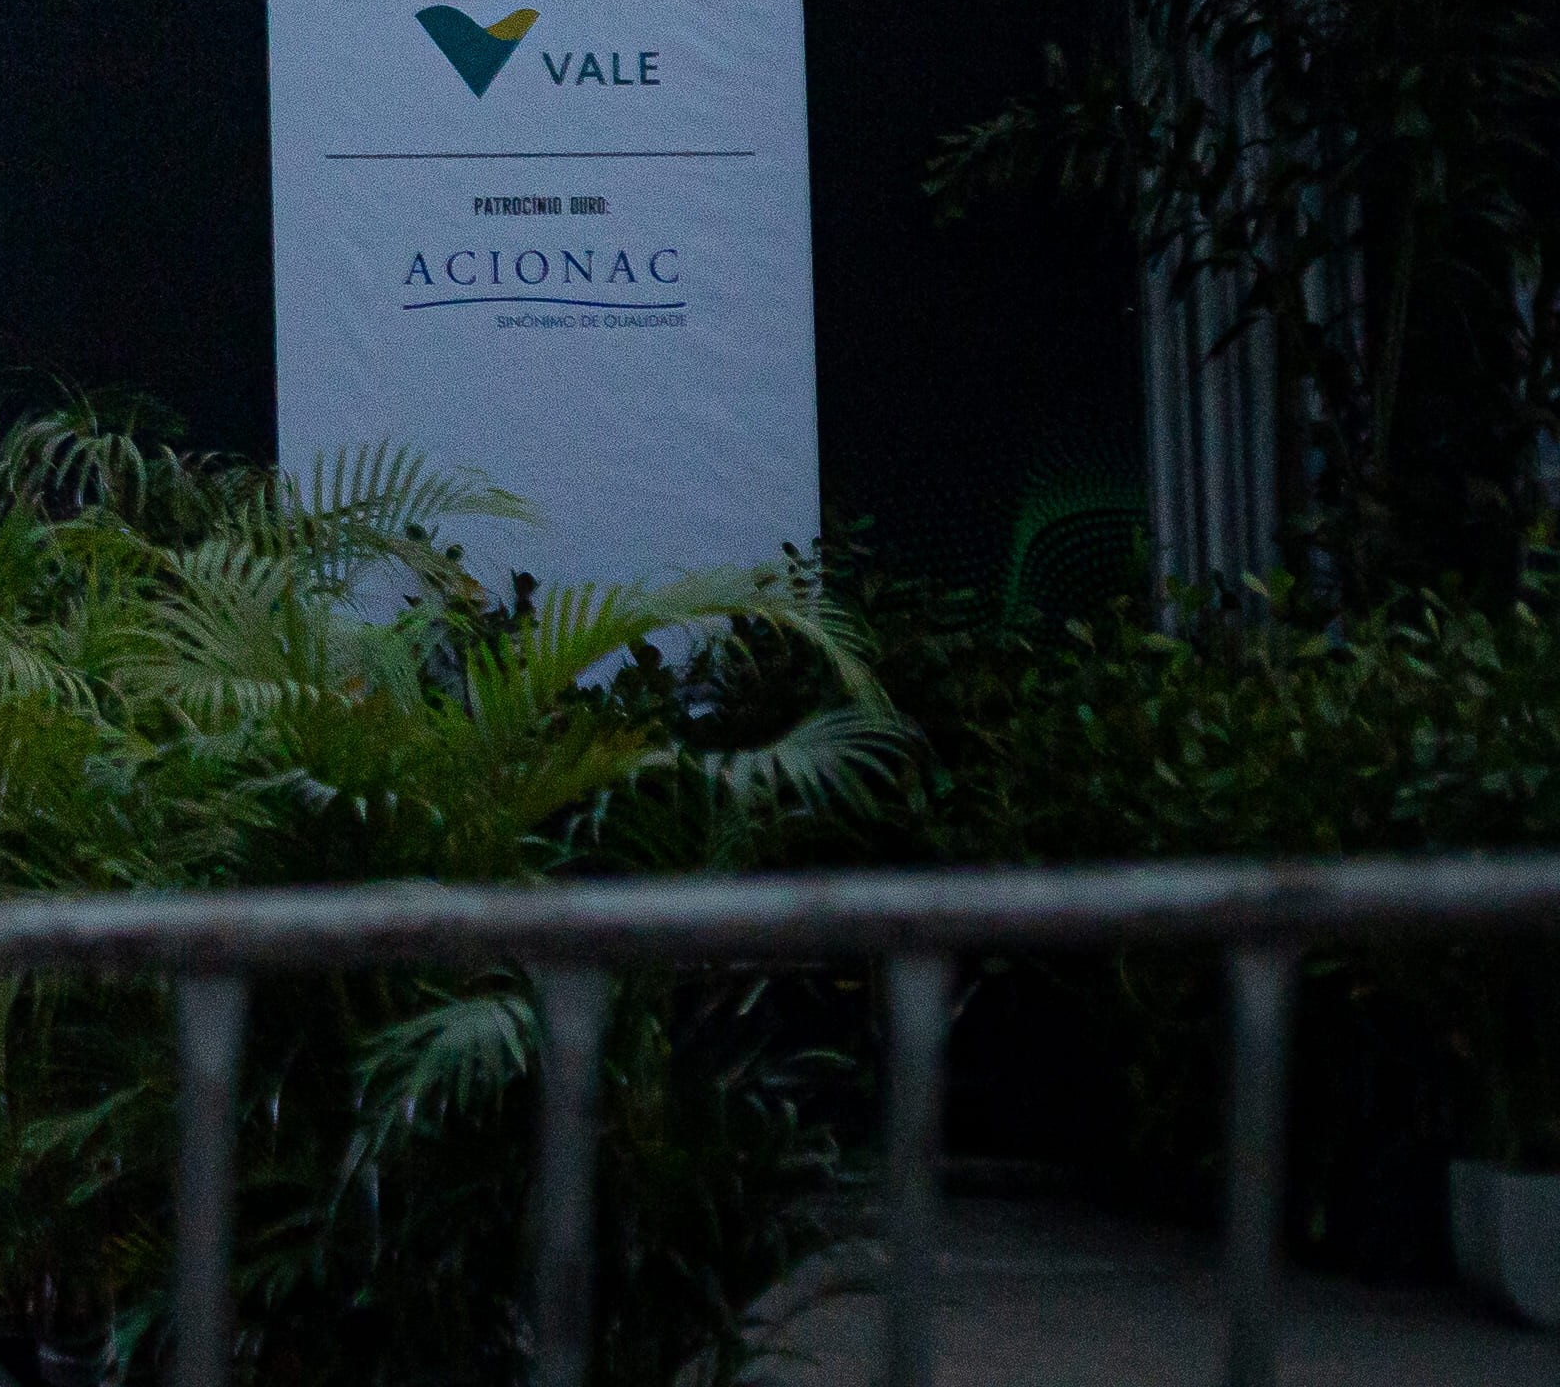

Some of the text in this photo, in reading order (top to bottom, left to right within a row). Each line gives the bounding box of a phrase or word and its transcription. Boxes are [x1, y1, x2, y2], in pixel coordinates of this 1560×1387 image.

[541, 51, 660, 86] VALE
[404, 248, 680, 285] ACIONAC
[581, 315, 600, 327] DE
